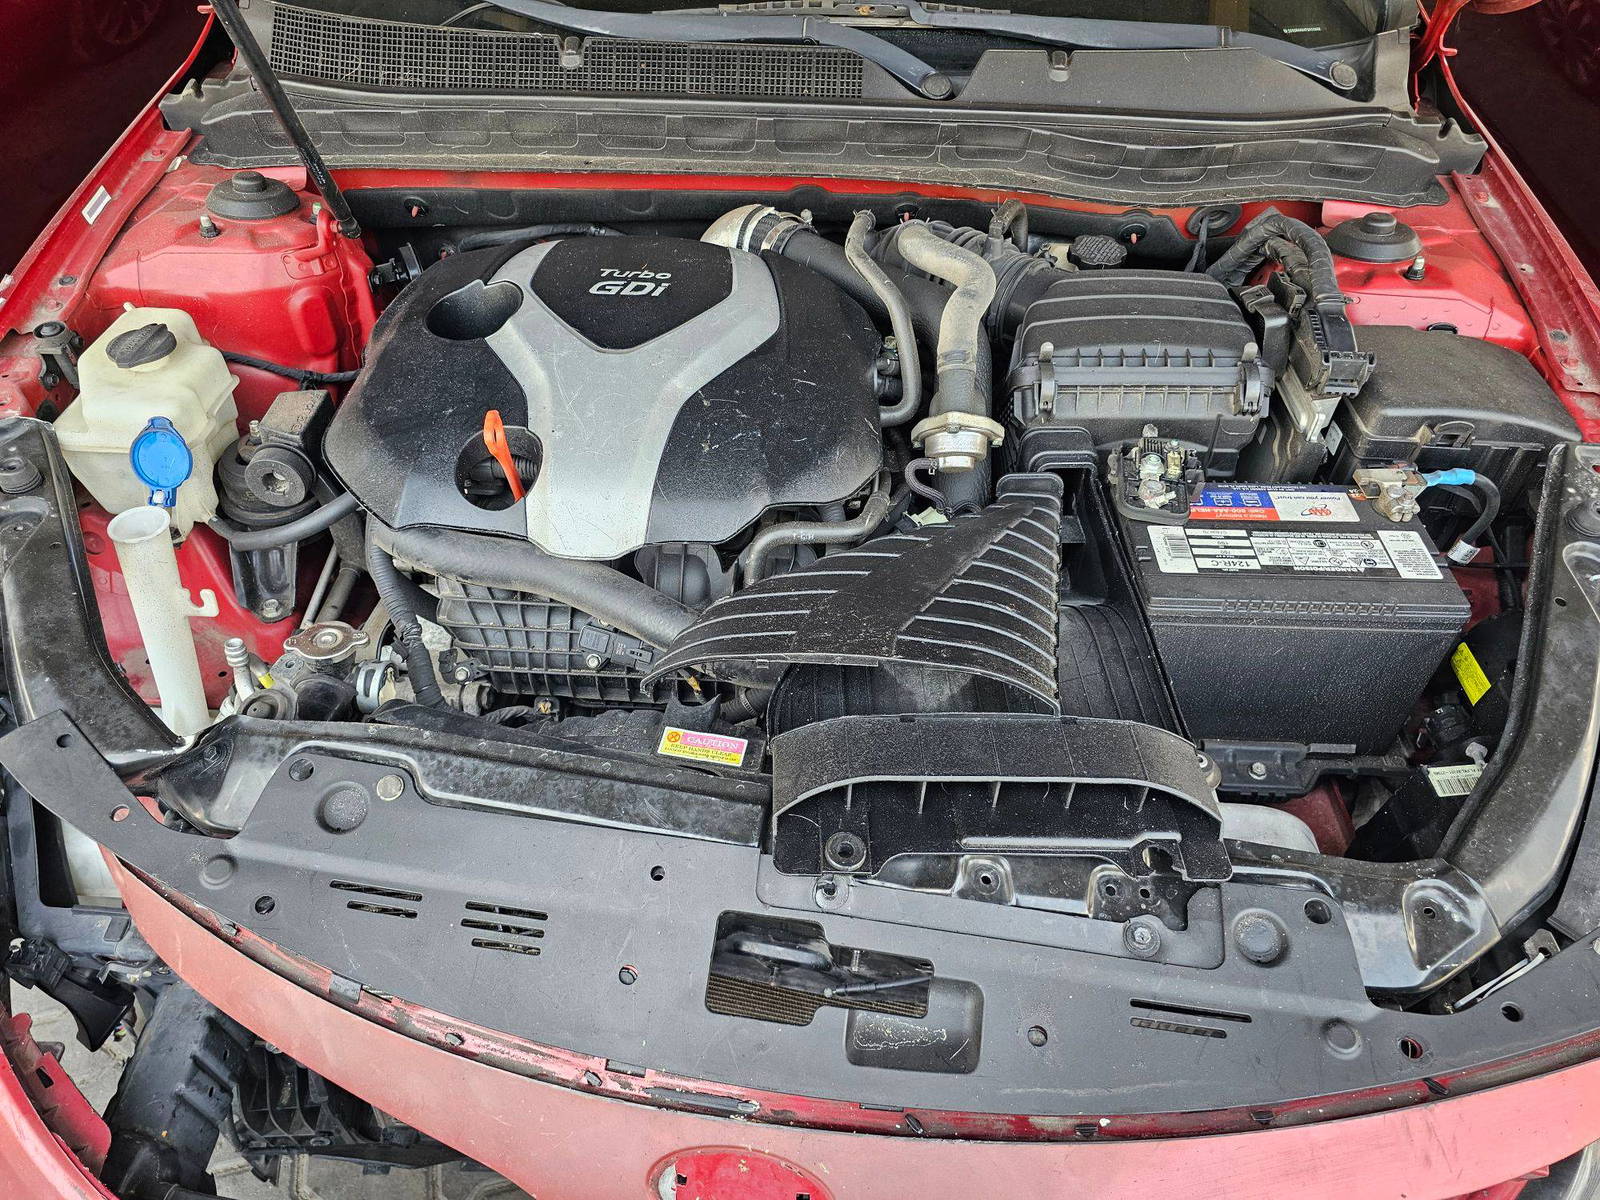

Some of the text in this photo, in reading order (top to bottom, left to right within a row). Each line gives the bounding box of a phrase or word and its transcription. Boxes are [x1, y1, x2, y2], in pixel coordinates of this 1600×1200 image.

[600, 268, 672, 279] Turbo
[588, 280, 671, 297] GDi
[686, 736, 739, 749] CAUTION
